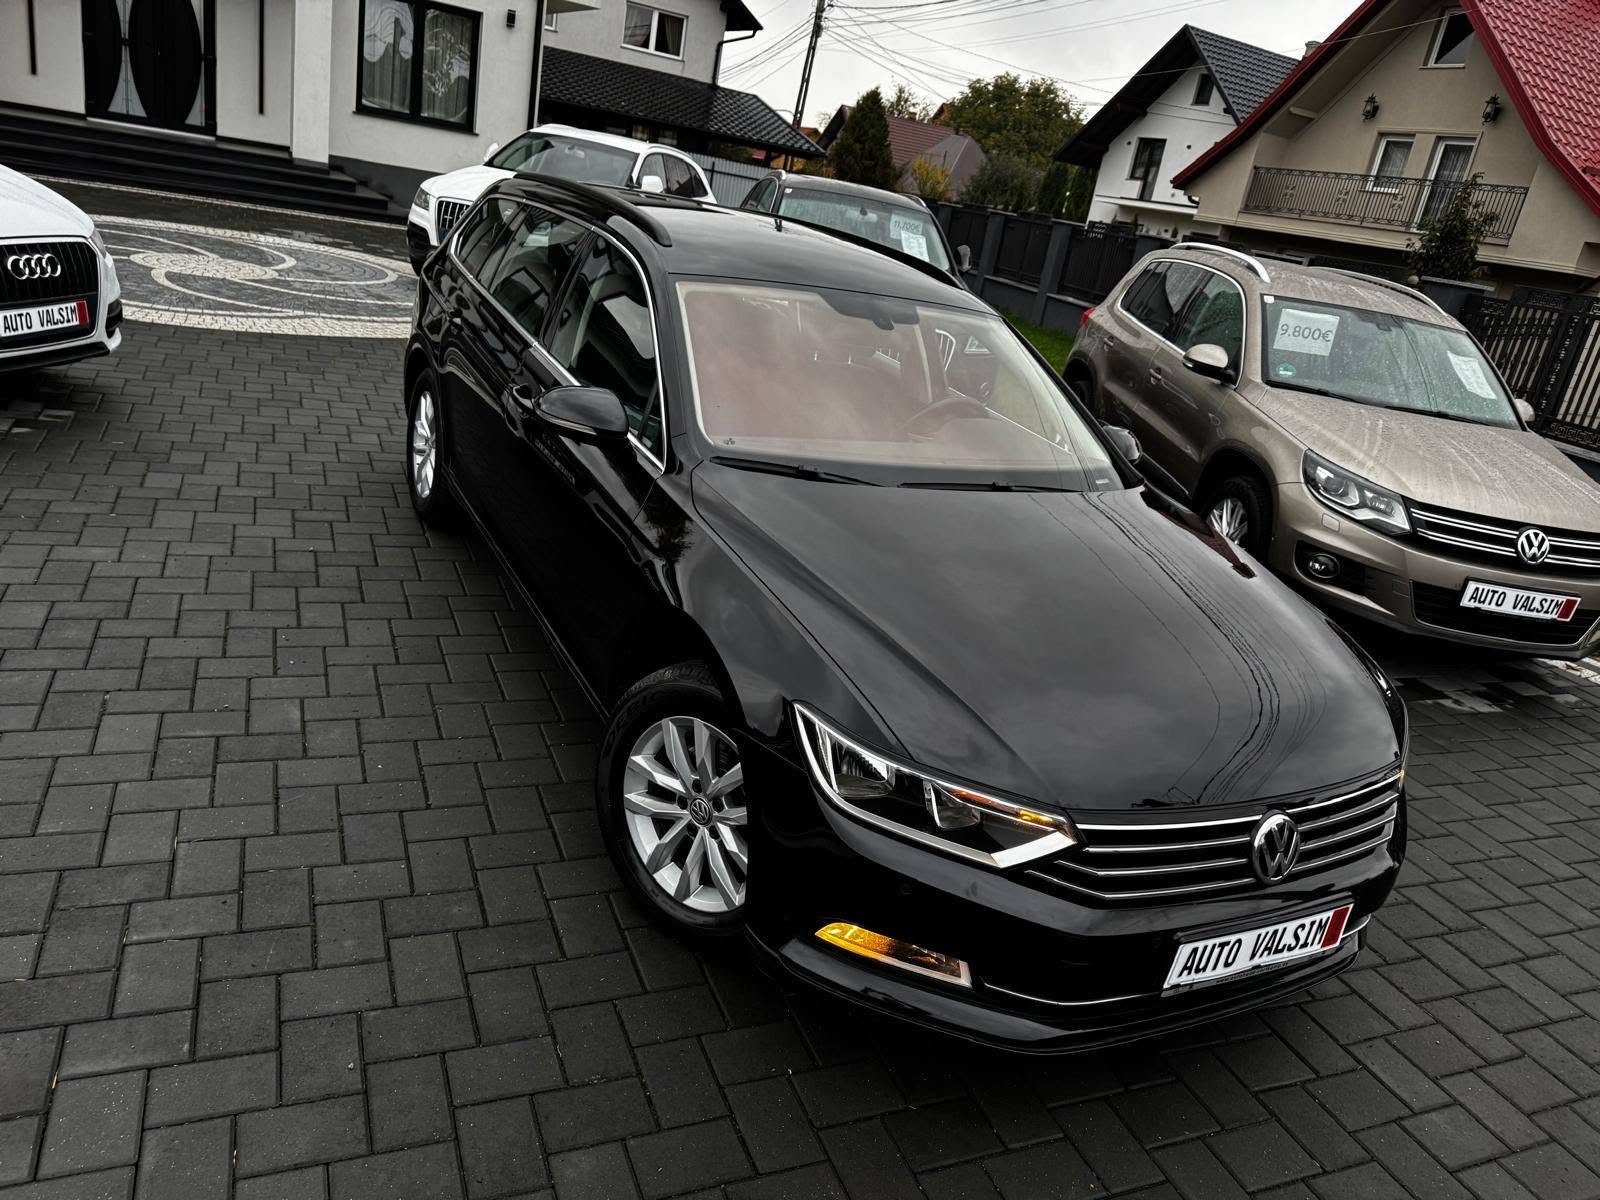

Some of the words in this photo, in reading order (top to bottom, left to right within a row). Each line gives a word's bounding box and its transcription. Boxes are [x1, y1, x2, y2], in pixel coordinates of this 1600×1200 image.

[3, 312, 32, 334] AUTO
[38, 304, 78, 328] VALSIM
[1280, 322, 1333, 342] 9.800€
[1468, 587, 1506, 607] AUTO
[1512, 594, 1564, 615] VALSIM
[1178, 938, 1243, 978] AUTO
[1249, 916, 1331, 961] VALSIM
